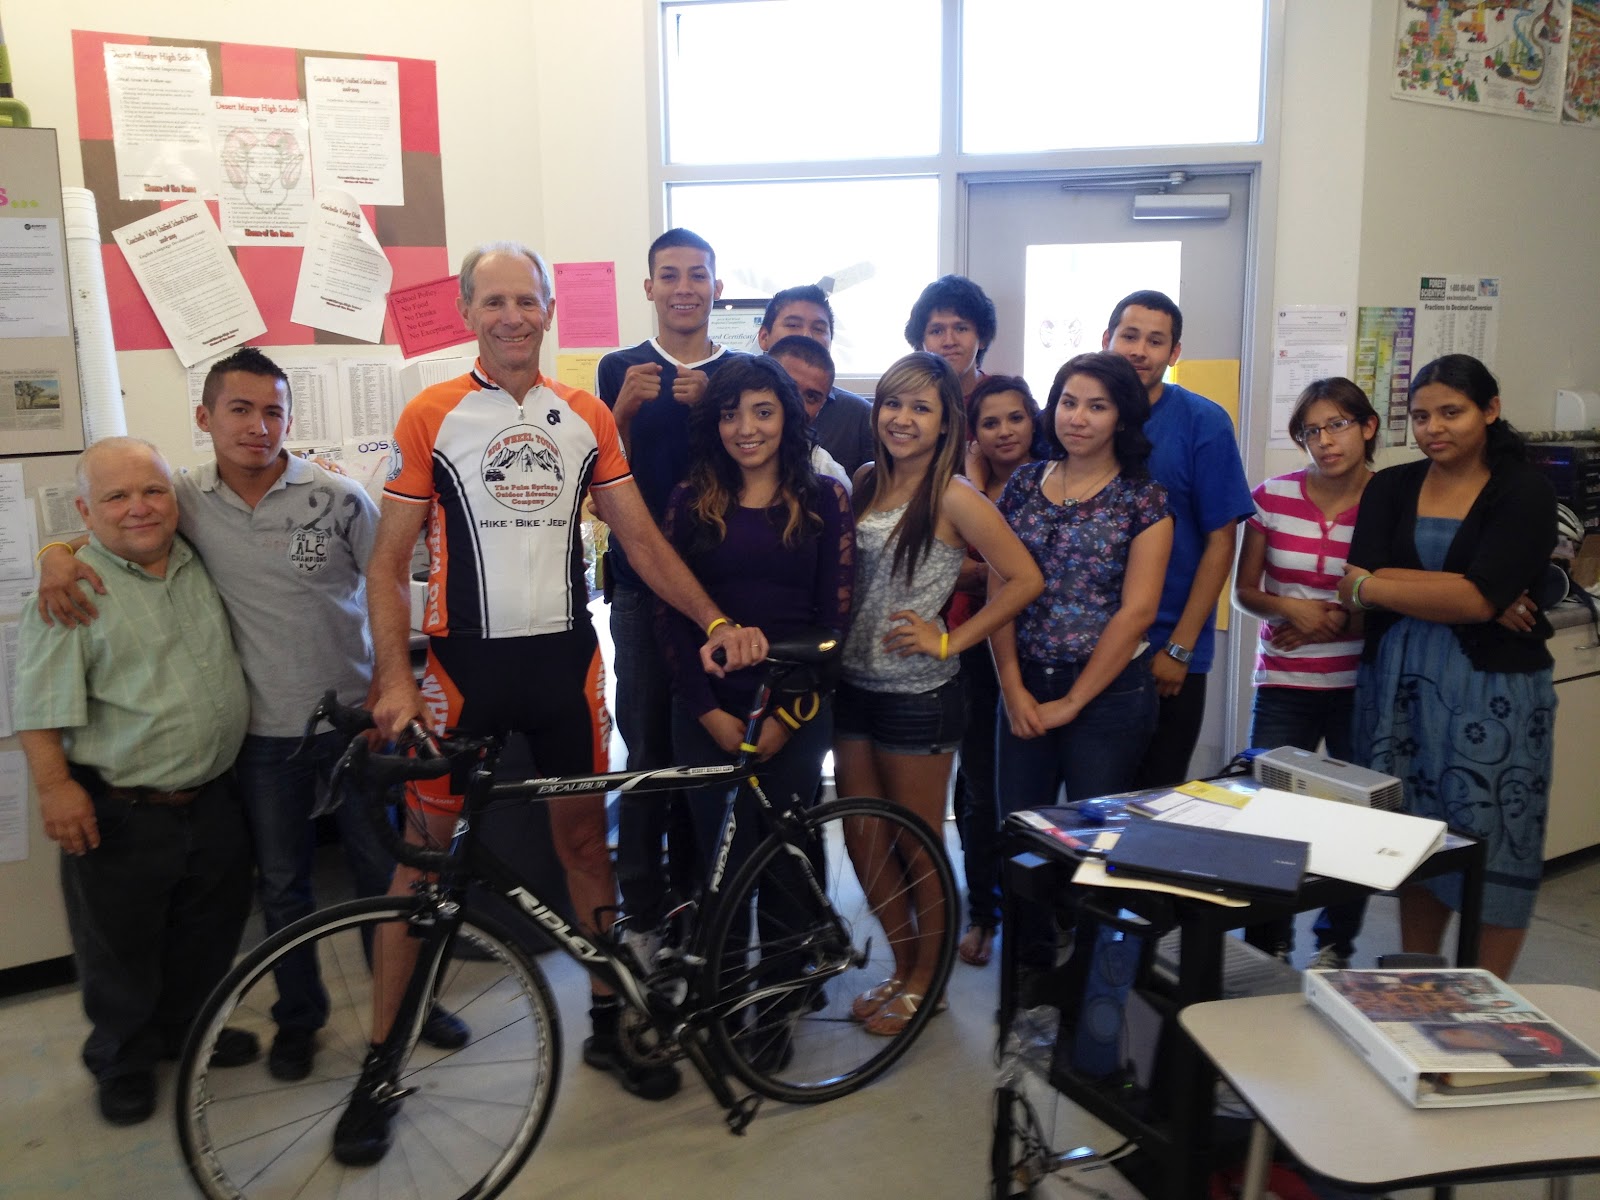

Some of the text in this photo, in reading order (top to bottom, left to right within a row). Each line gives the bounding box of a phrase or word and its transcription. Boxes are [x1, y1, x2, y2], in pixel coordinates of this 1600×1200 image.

[216, 102, 236, 110] Desert
[238, 103, 259, 114] Mirage
[261, 104, 277, 114] High
[340, 208, 351, 218] Valley
[144, 229, 158, 238] Valley
[156, 224, 172, 233] Unified
[172, 218, 184, 227] School
[183, 213, 198, 222] District
[395, 290, 437, 304] School Policy
[413, 300, 428, 309] Food
[415, 309, 437, 319] Drinks
[421, 324, 454, 337] Exceptions
[487, 433, 559, 458] BIG WHEEL TOURS
[516, 519, 540, 527] BIKE
[547, 519, 567, 527] JEEP
[428, 582, 439, 627] BIG
[537, 781, 607, 794] EXCALIBUR
[710, 811, 737, 893] RIDLEY
[506, 886, 609, 961] RIDLEY
